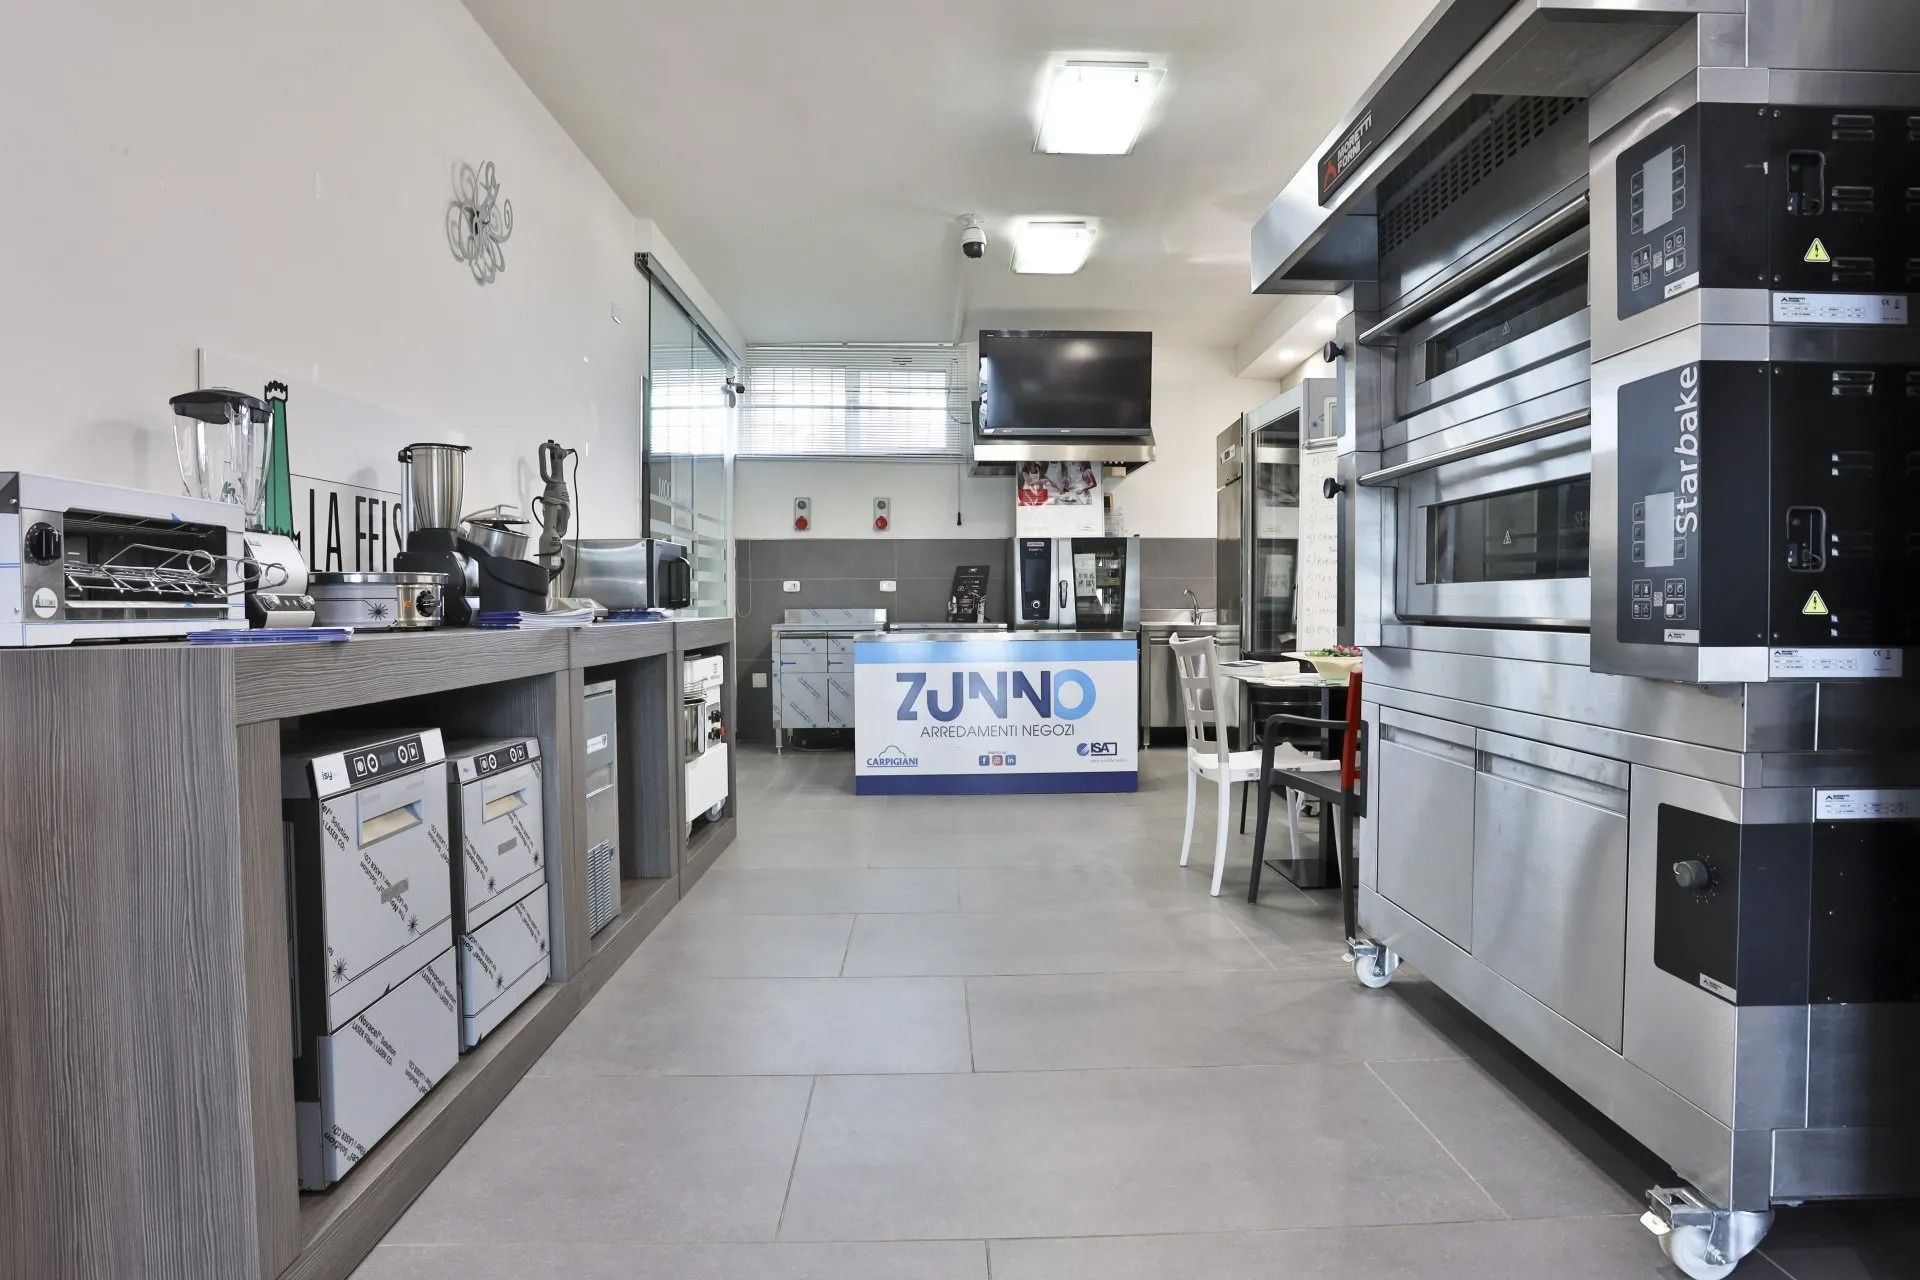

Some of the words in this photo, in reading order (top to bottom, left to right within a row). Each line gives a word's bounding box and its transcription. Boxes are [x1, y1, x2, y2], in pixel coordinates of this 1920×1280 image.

[1337, 114, 1372, 162] MORETTI
[1337, 140, 1361, 174] FORNI
[1674, 366, 1698, 533] Starbake
[309, 489, 343, 572] LA
[896, 668, 1097, 722] ZUNNO
[920, 725, 1018, 738] ARREDAMENTI
[1022, 724, 1075, 737] NEGOZI
[866, 757, 919, 766] CARPIGIANI
[1090, 743, 1110, 753] ISA
[321, 771, 333, 781] isy
[324, 822, 339, 840] LASER
[331, 815, 350, 842] Solution
